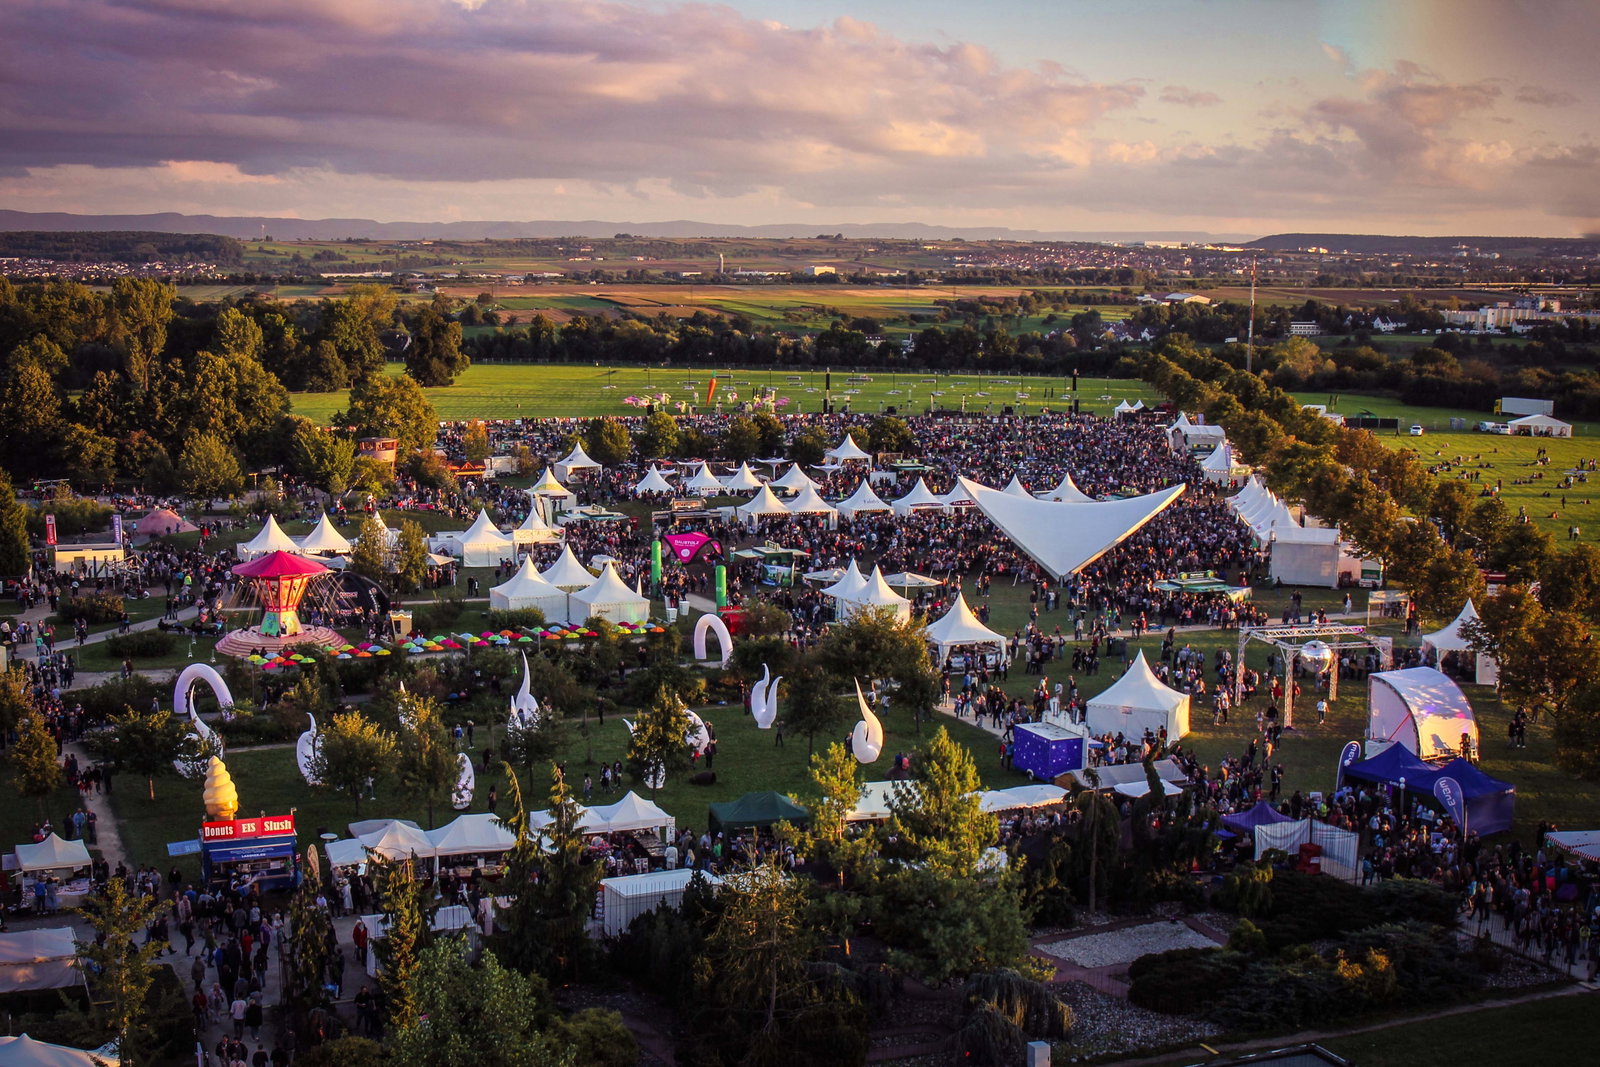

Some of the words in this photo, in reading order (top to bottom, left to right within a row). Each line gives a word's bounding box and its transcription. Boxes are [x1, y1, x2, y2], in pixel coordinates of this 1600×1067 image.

[1345, 744, 1357, 766] nBW
[205, 826, 234, 837] Donuts
[241, 823, 256, 833] EIS
[264, 820, 292, 831] Slush
